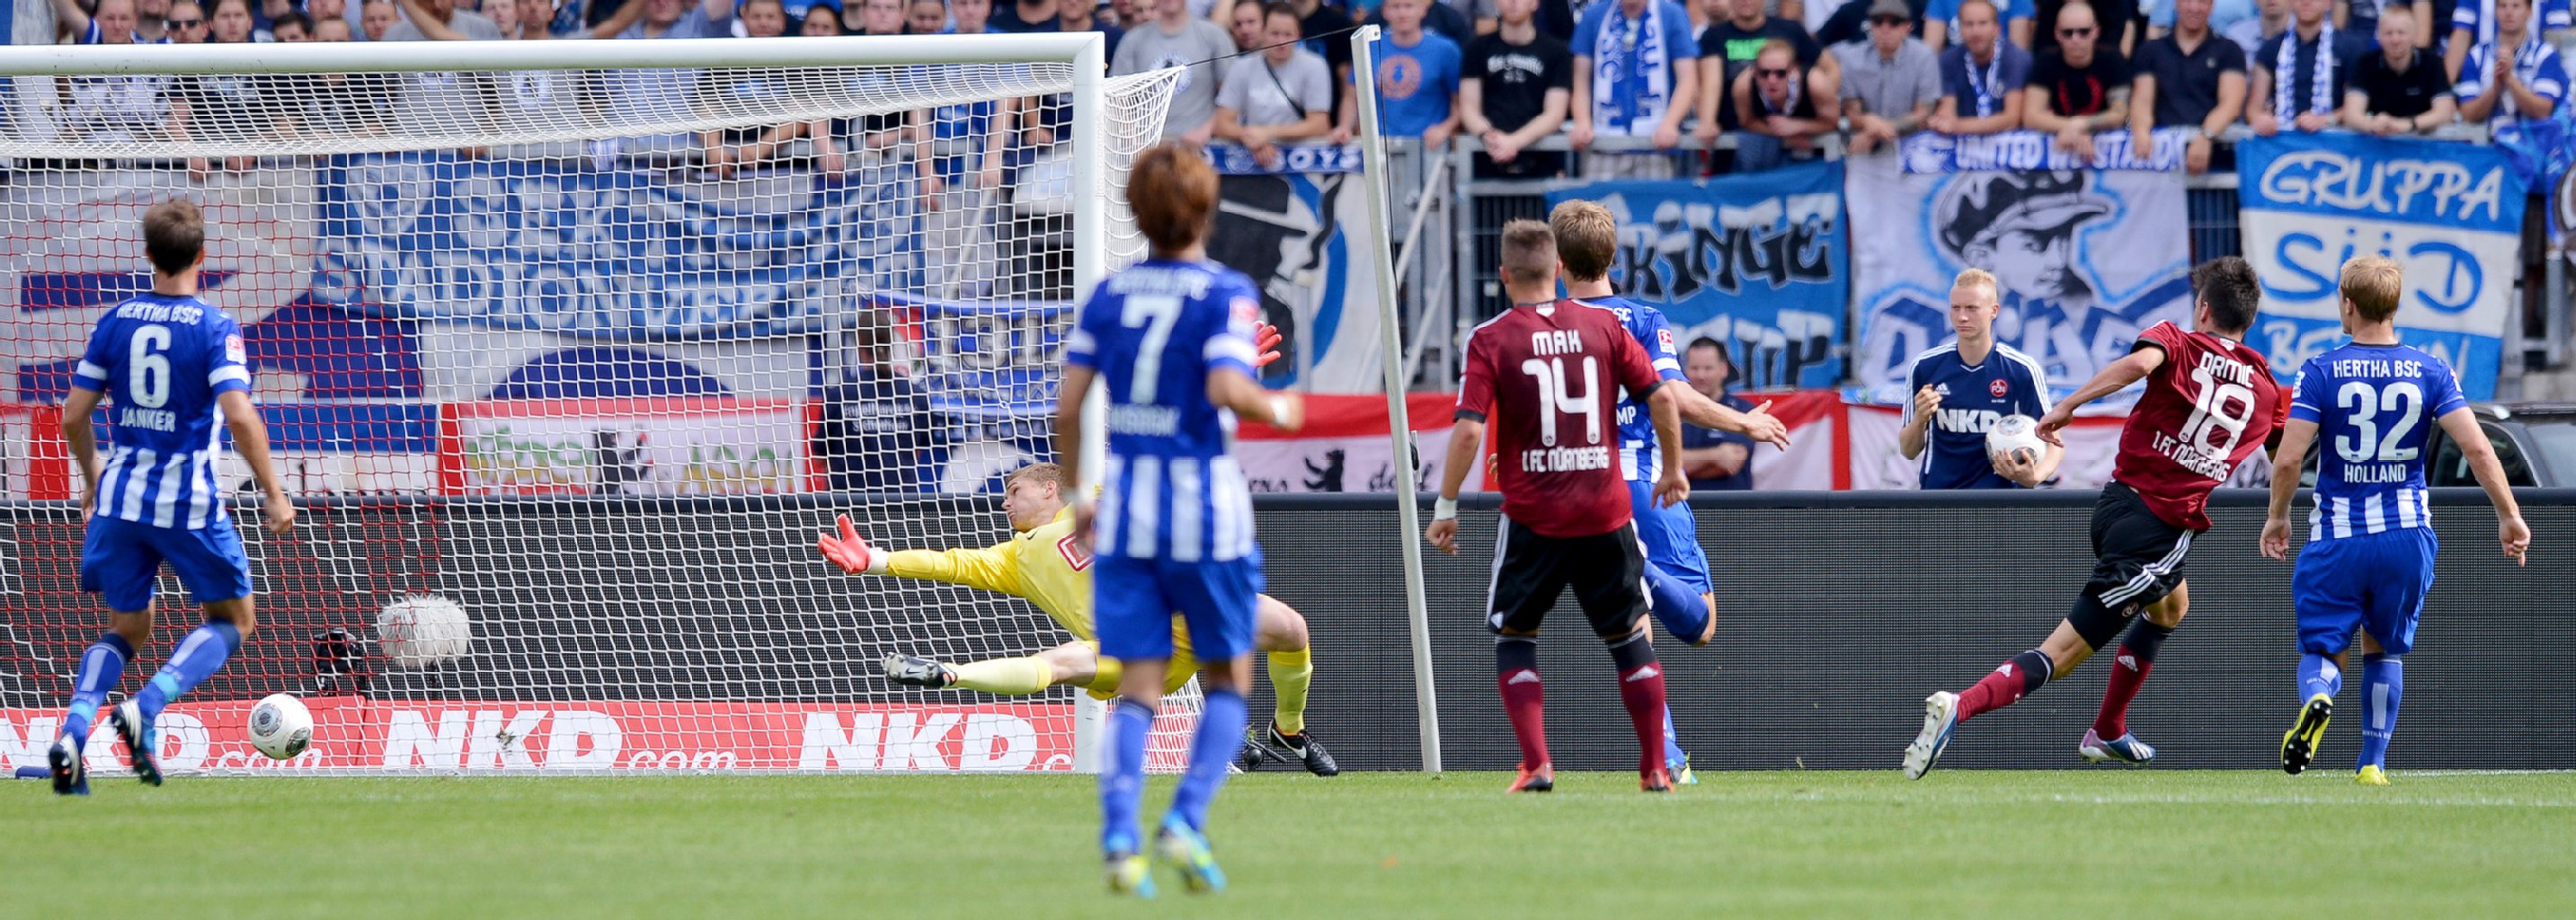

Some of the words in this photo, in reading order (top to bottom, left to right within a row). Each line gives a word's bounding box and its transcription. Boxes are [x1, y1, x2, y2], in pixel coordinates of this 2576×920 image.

[1956, 132, 2044, 171] UNITED
[2259, 150, 2504, 222] GRUPPA
[2261, 227, 2483, 315] SD
[116, 302, 171, 323] HERTHA
[170, 304, 204, 325] BSC
[1612, 307, 1632, 322] SC
[1120, 295, 1185, 404] 7
[1531, 329, 1583, 357] MAK
[129, 323, 172, 409] 6
[2333, 359, 2391, 378] HERTHA
[2394, 359, 2422, 378] BSC
[119, 406, 176, 432] JANKER
[1521, 355, 1601, 447] 14
[2178, 367, 2255, 461] 18
[2335, 381, 2423, 461] 32
[1547, 446, 1610, 473] NÜRNBERG
[2344, 463, 2407, 484] HOLLAND
